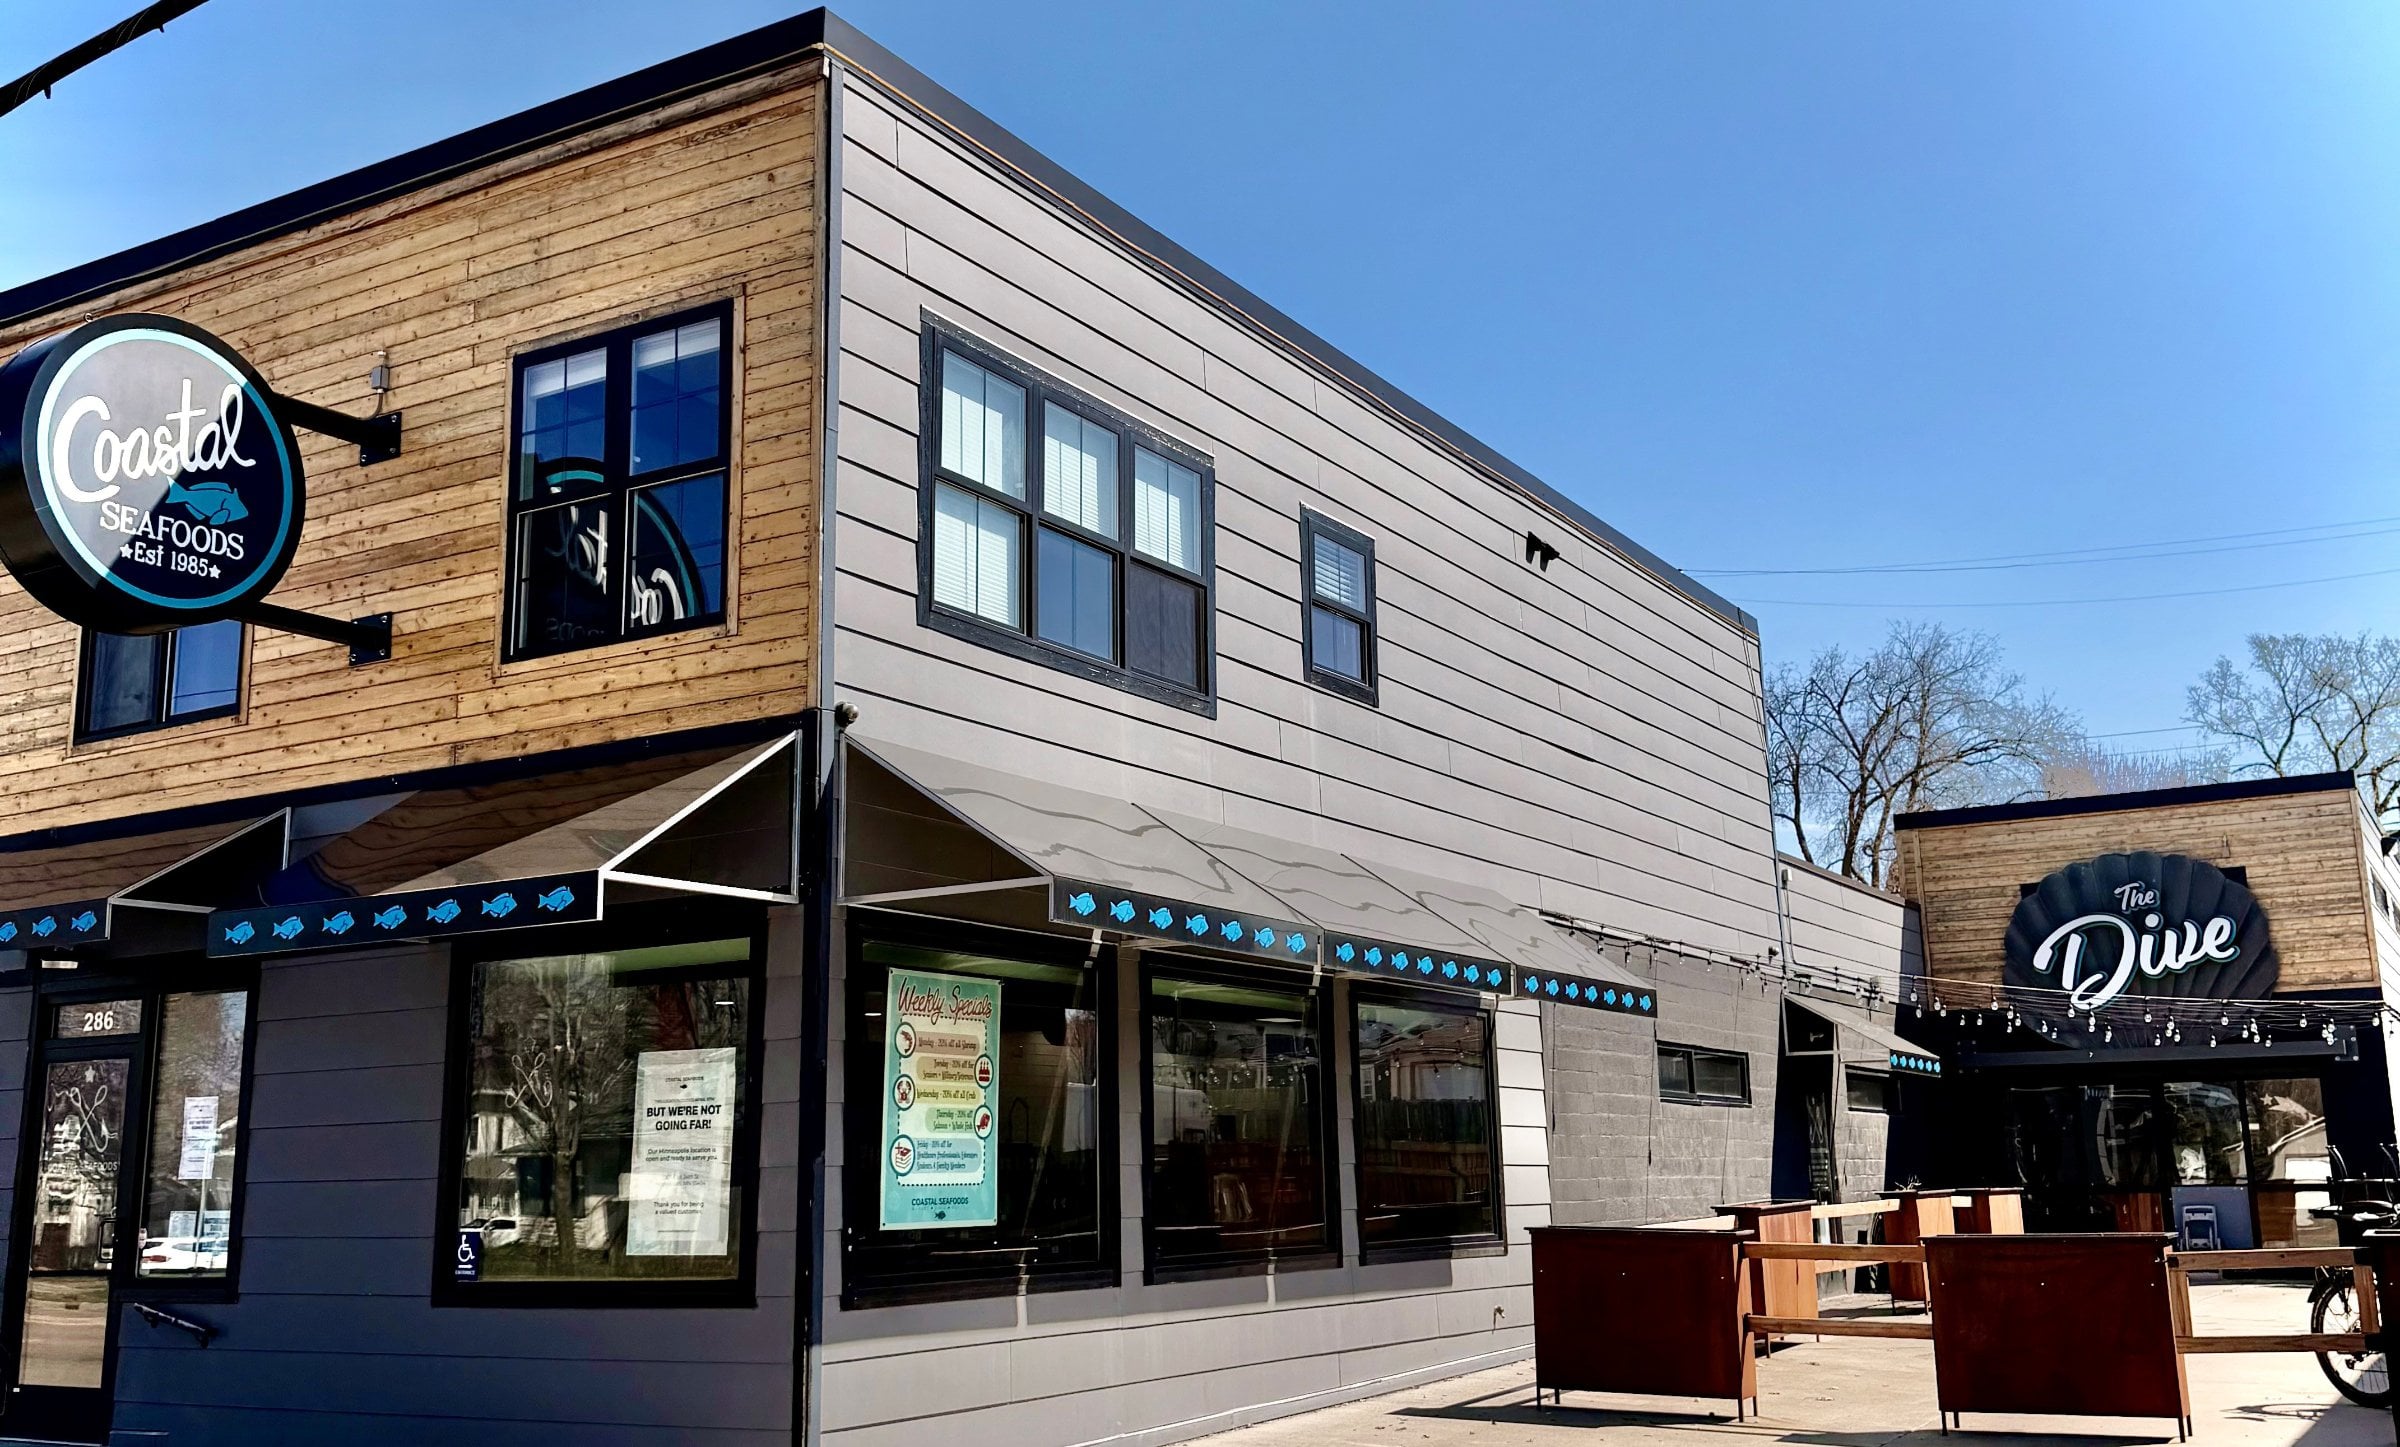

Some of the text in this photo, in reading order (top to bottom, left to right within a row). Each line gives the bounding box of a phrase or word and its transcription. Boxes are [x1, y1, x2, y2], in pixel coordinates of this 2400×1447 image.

[53, 378, 256, 503] Coastal
[100, 501, 245, 560] SEAFOODS
[135, 543, 209, 577] Est 1985
[2114, 882, 2157, 912] The
[2033, 913, 2237, 1011] Dive
[898, 977, 993, 1025] Weekly Specials
[83, 1010, 114, 1032] 286
[646, 1104, 721, 1117] BUT WE'RE NOT
[655, 1119, 711, 1131] GOING FAR!
[911, 1196, 969, 1206] COASTAL SEAFOODS
